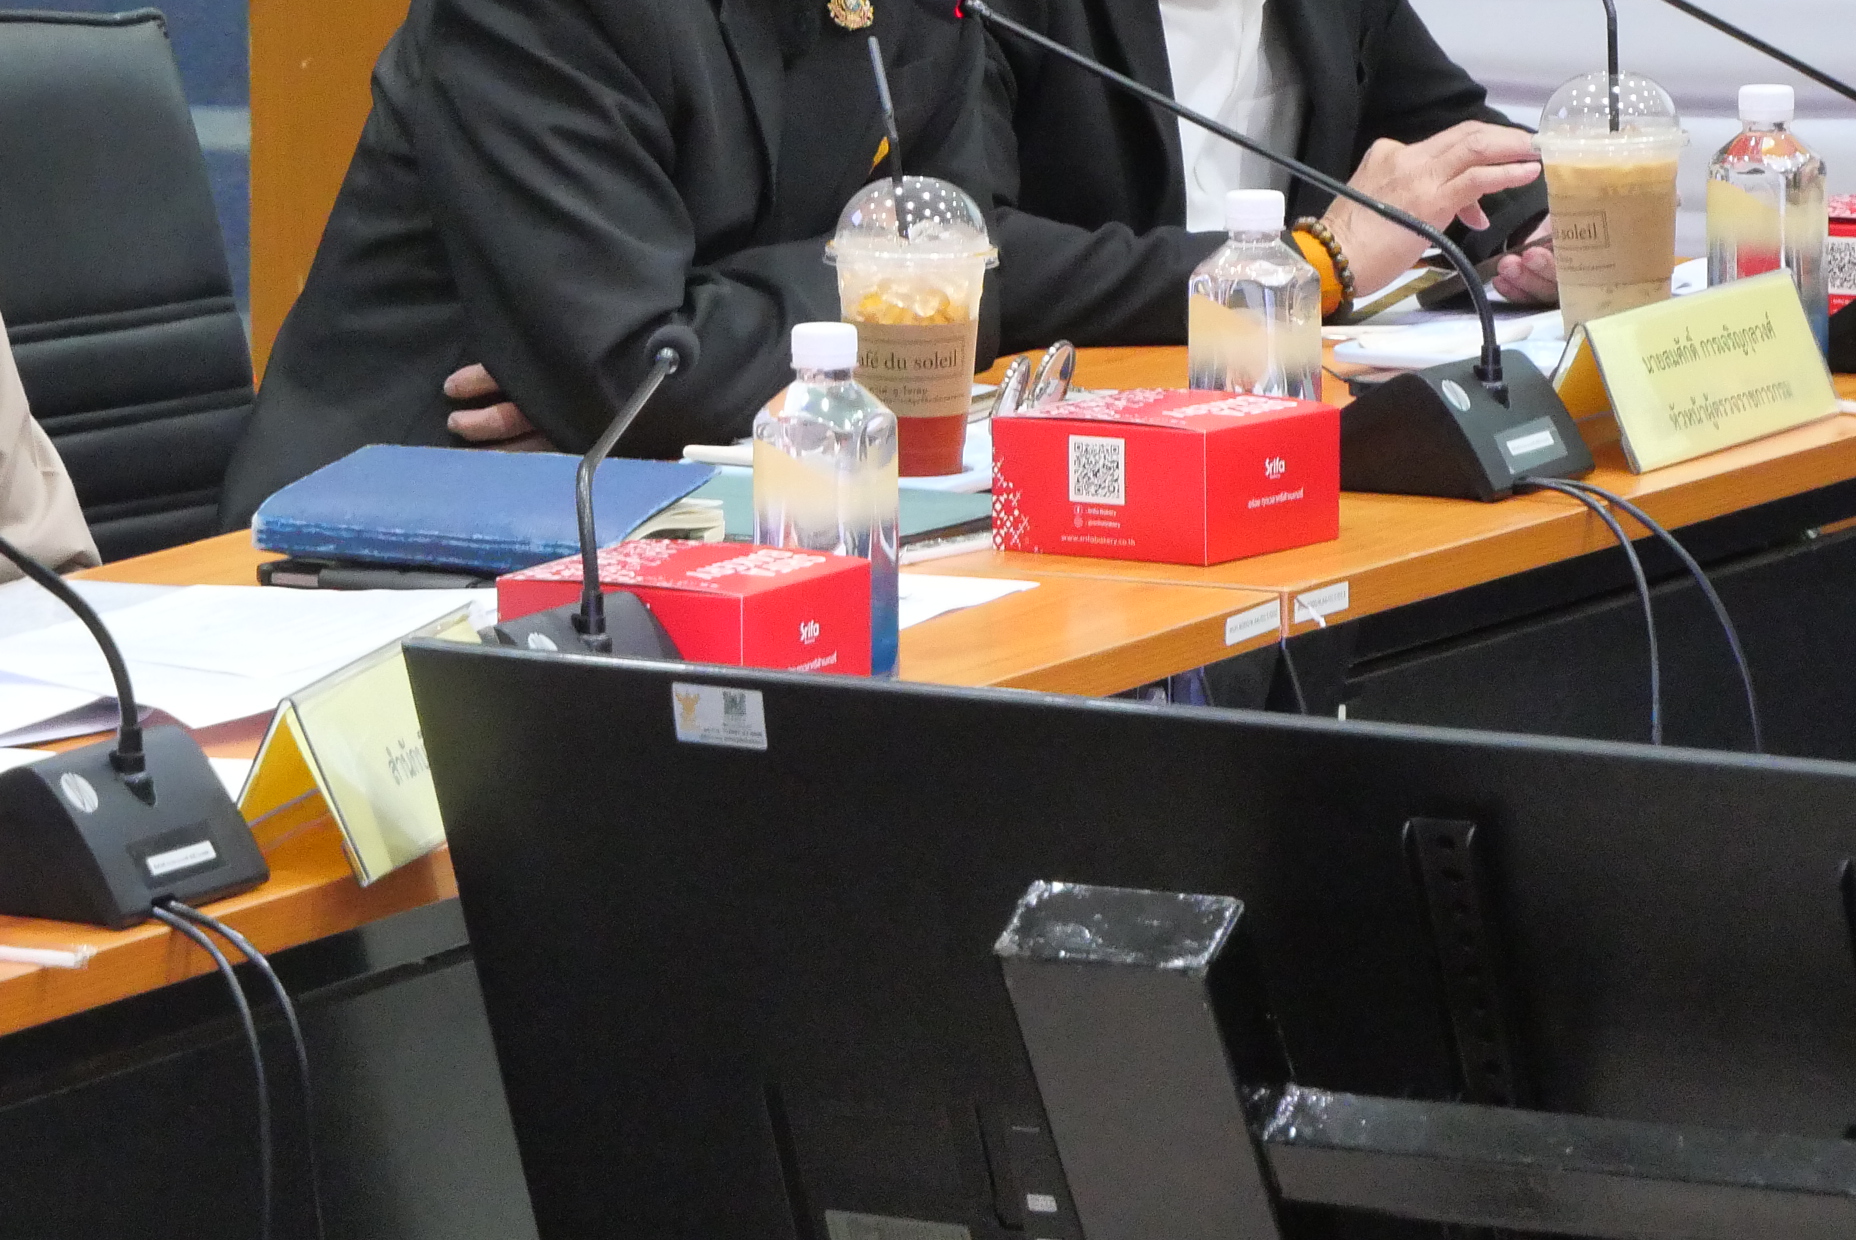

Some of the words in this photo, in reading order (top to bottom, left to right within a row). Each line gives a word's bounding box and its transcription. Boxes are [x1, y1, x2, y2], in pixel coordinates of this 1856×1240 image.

[1561, 222, 1597, 241] soleil
[857, 350, 880, 370] afé
[884, 351, 907, 371] du
[913, 348, 957, 371] soleil
[1265, 456, 1286, 477] Srifa
[800, 620, 821, 642] Srifa
